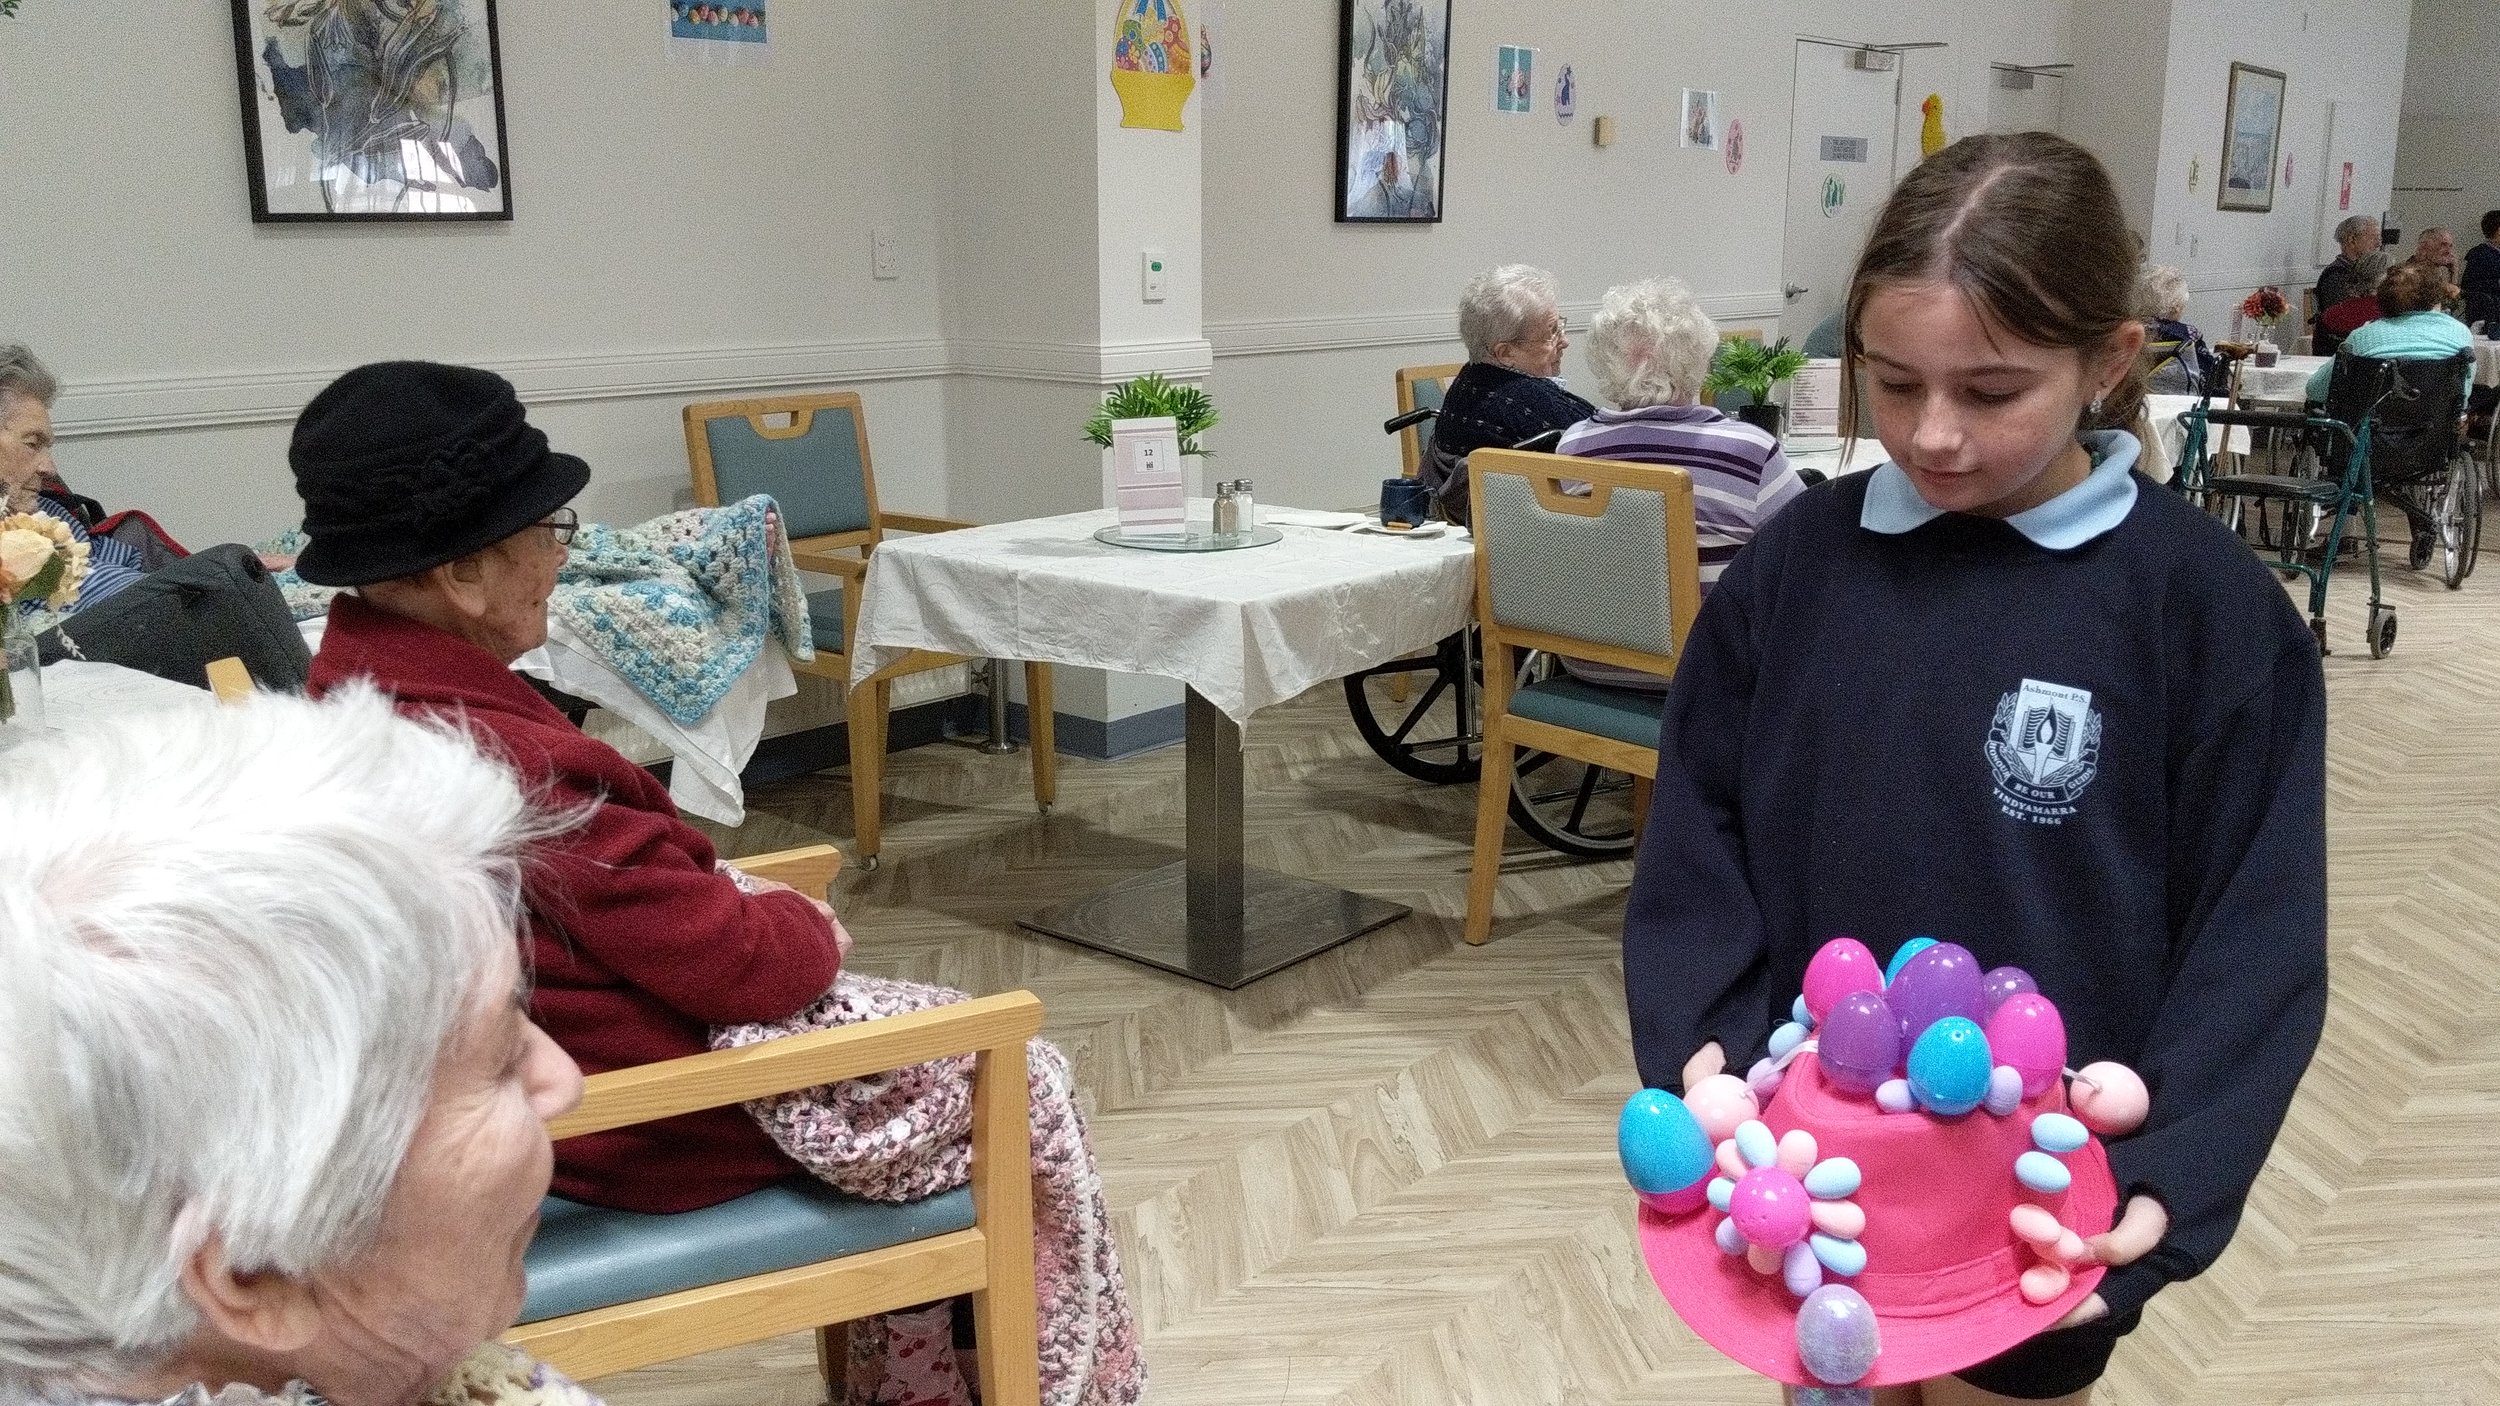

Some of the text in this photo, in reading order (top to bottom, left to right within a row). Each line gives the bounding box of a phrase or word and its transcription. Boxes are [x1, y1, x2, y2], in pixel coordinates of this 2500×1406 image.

[1144, 448, 1153, 456] 12
[2022, 683, 2088, 704] Ashmont P.S.
[1989, 742, 2095, 799] HONOUR BE OUR GUIDE
[1992, 787, 2077, 815] YINDYAMARRA
[2001, 805, 2062, 825] EST. 1966
